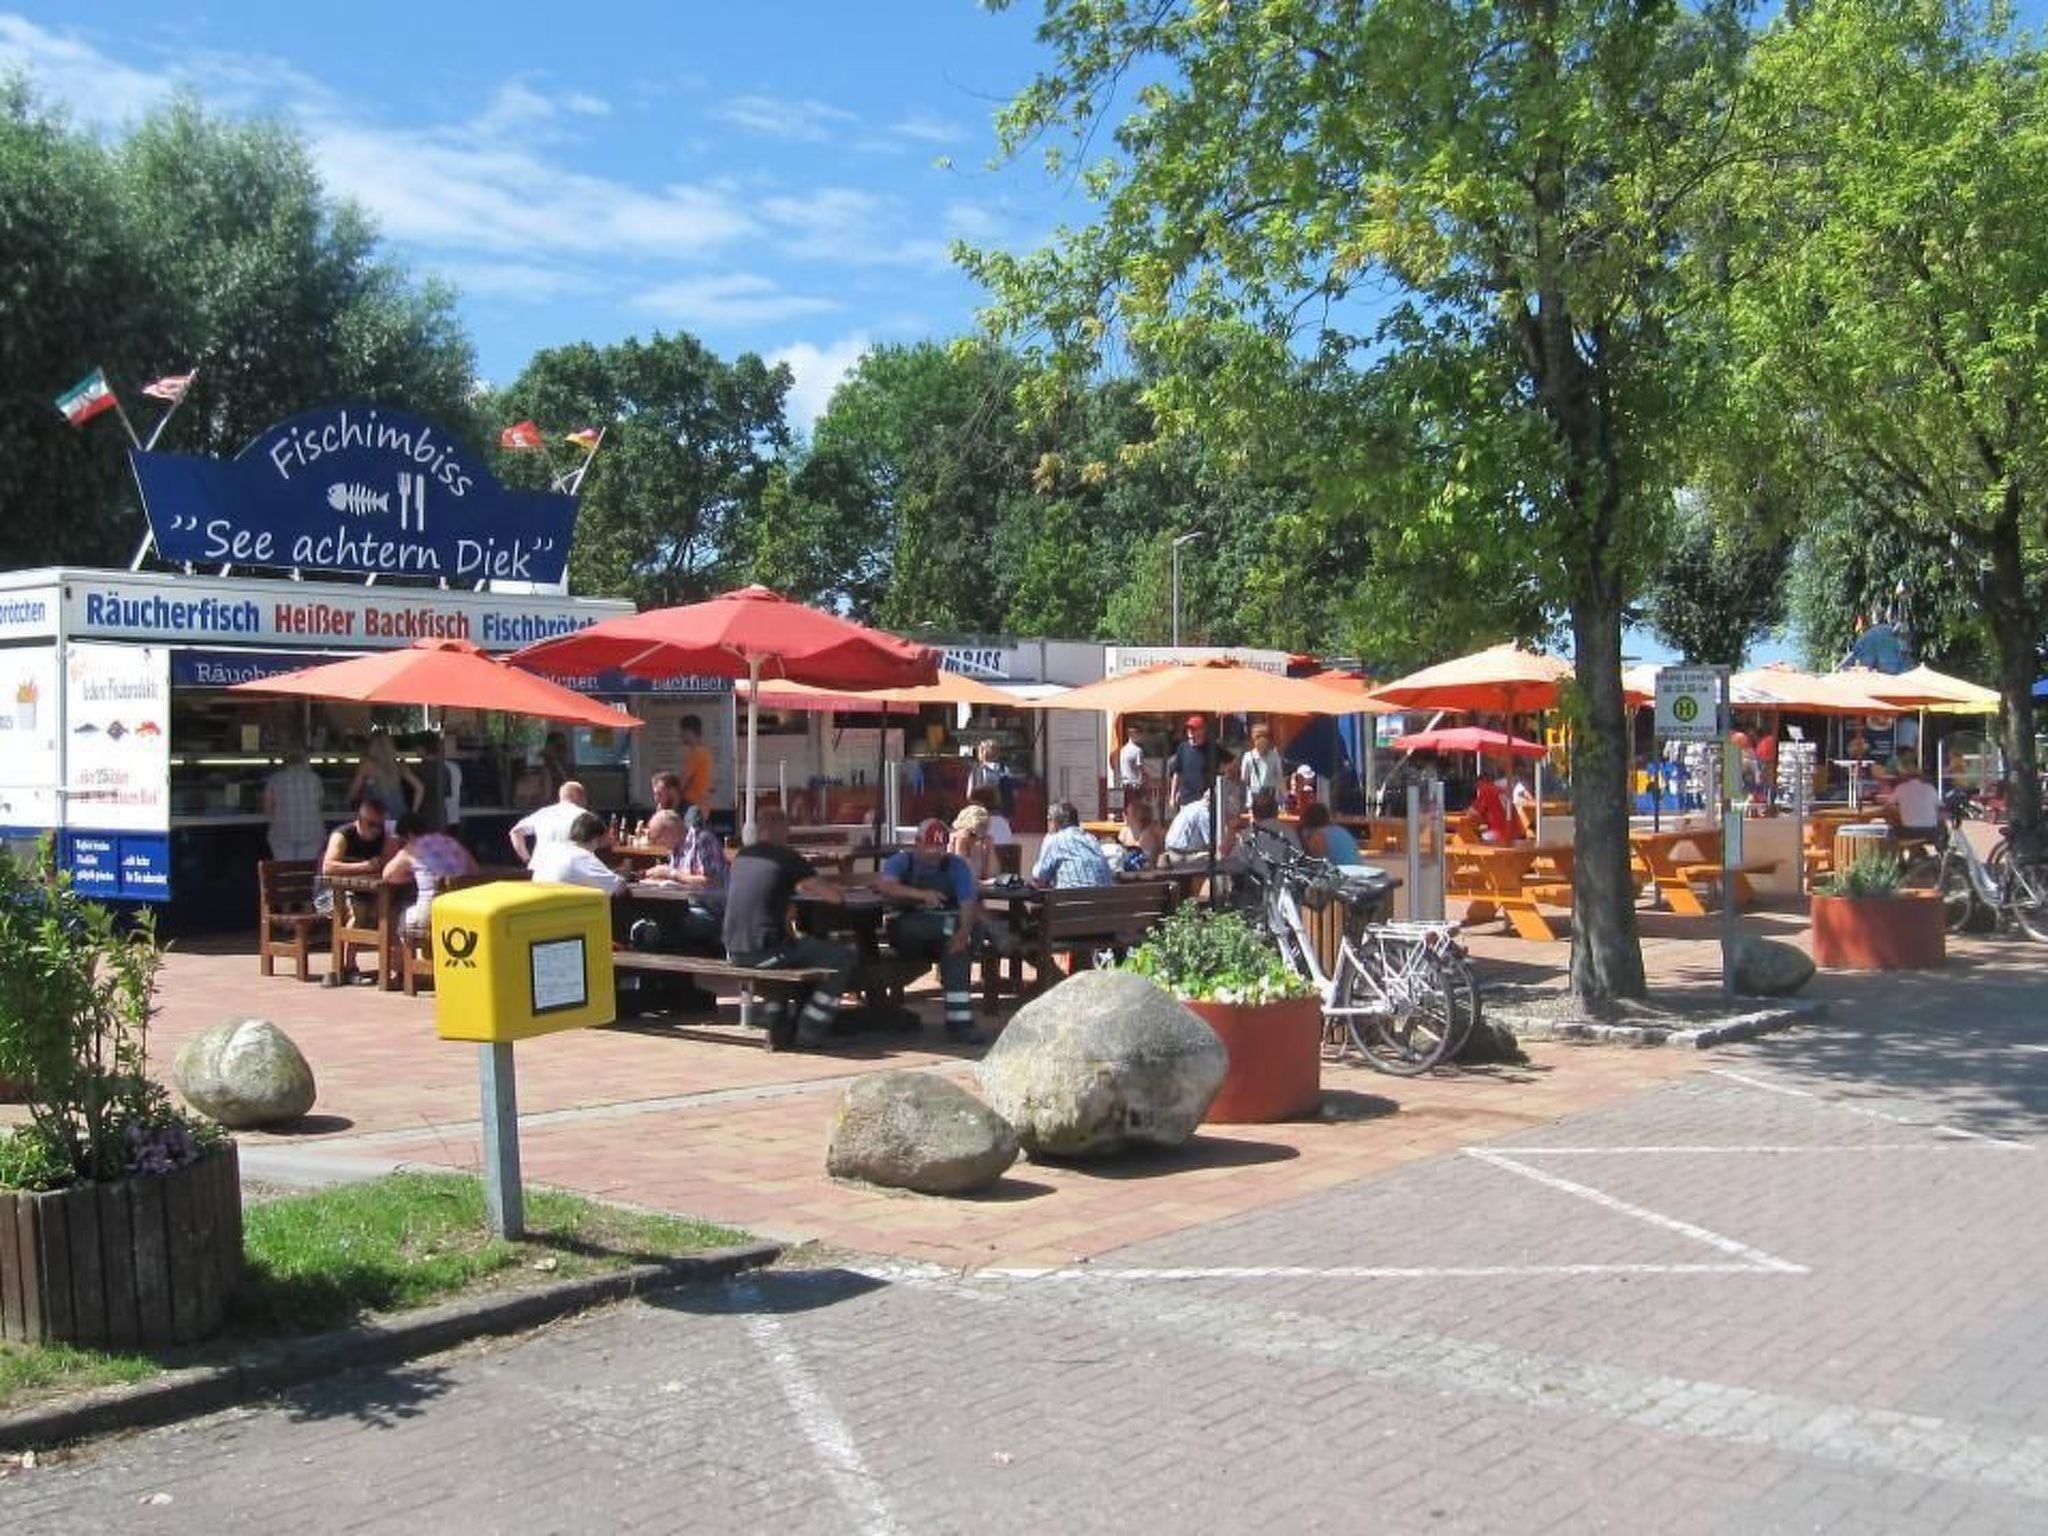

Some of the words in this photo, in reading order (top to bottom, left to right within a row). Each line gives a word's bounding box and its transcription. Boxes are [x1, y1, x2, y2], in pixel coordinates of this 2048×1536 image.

[270, 410, 473, 497] Fischimbiss
[292, 525, 441, 570] achtern
[87, 591, 260, 633] Räucherfisch
[275, 603, 355, 636] Heißer
[364, 607, 470, 639] Backfisch
